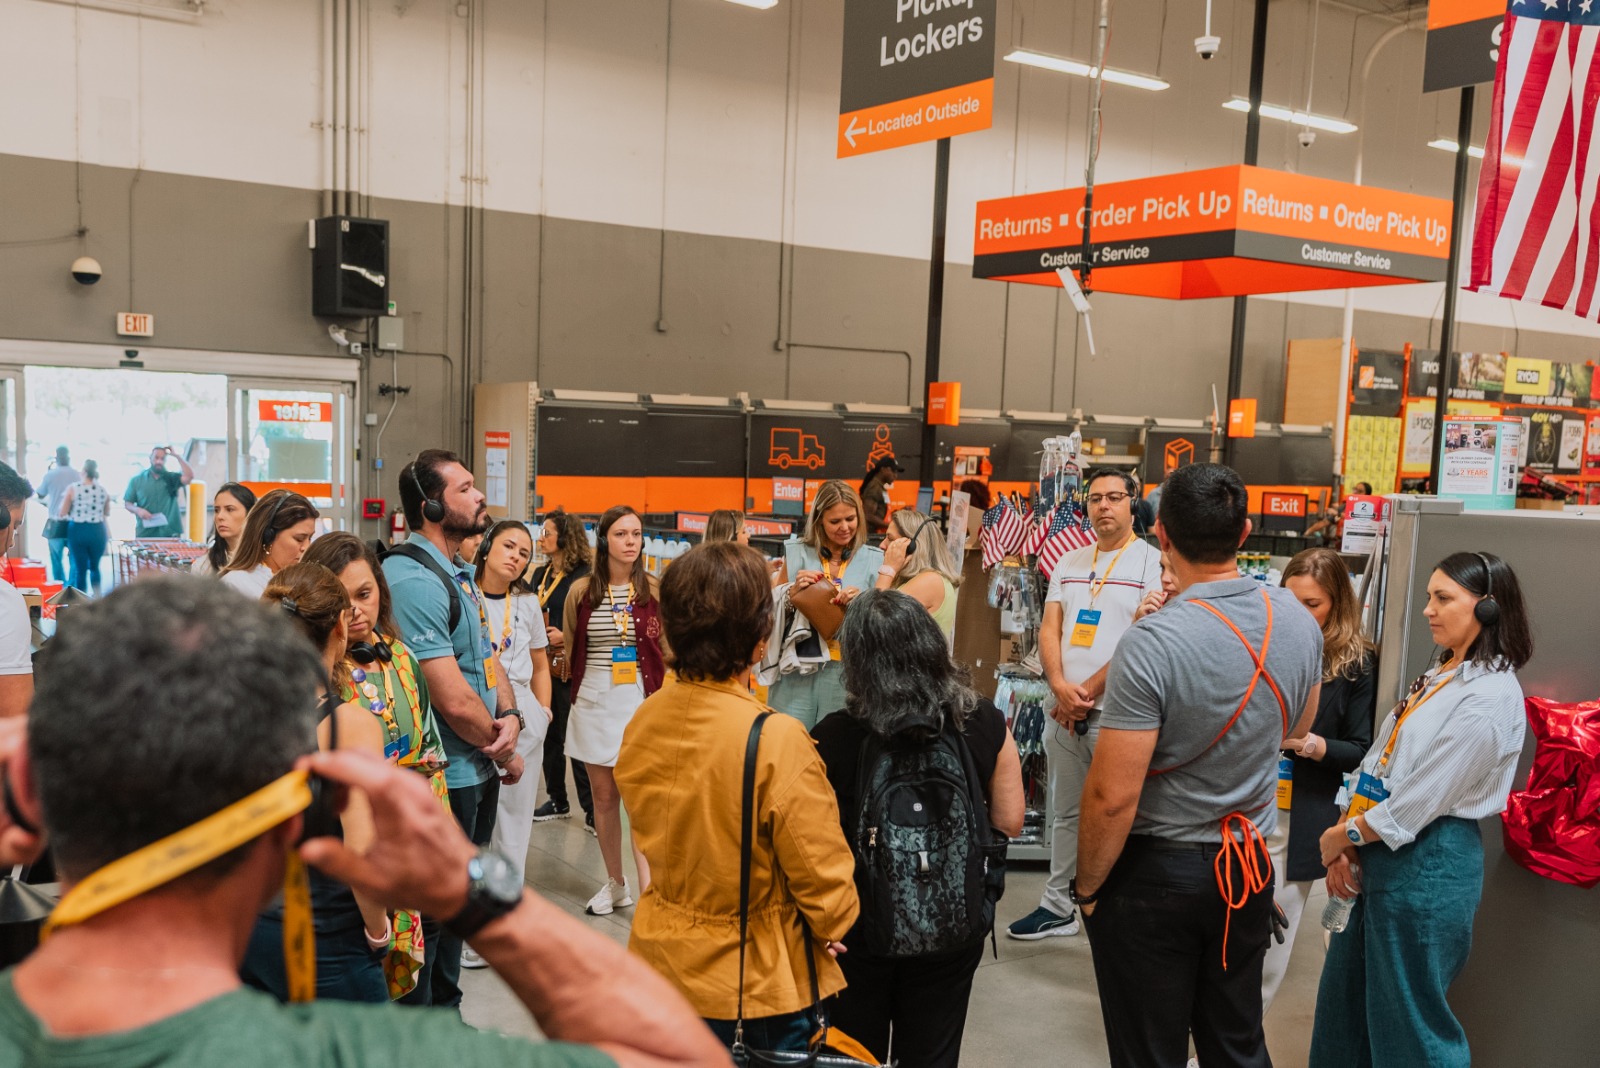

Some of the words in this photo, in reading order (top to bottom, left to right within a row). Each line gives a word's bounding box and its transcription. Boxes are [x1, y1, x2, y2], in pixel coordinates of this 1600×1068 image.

[880, 16, 983, 67] Lockers
[868, 108, 922, 135] Located
[925, 97, 980, 123] Outside
[979, 213, 1052, 240] Returns
[1142, 194, 1190, 222] Pick
[1198, 190, 1231, 219] Up
[1243, 188, 1314, 223] Returns
[1333, 203, 1382, 233] Order
[1386, 211, 1420, 239] Pick
[1424, 218, 1447, 247] Up
[1101, 245, 1150, 263] Service
[1301, 243, 1352, 265] Customer
[1354, 250, 1391, 270] Service
[124, 315, 148, 333] EXIT
[774, 481, 803, 498] Enter
[1270, 497, 1299, 513] Exit
[1361, 502, 1367, 511] 2
